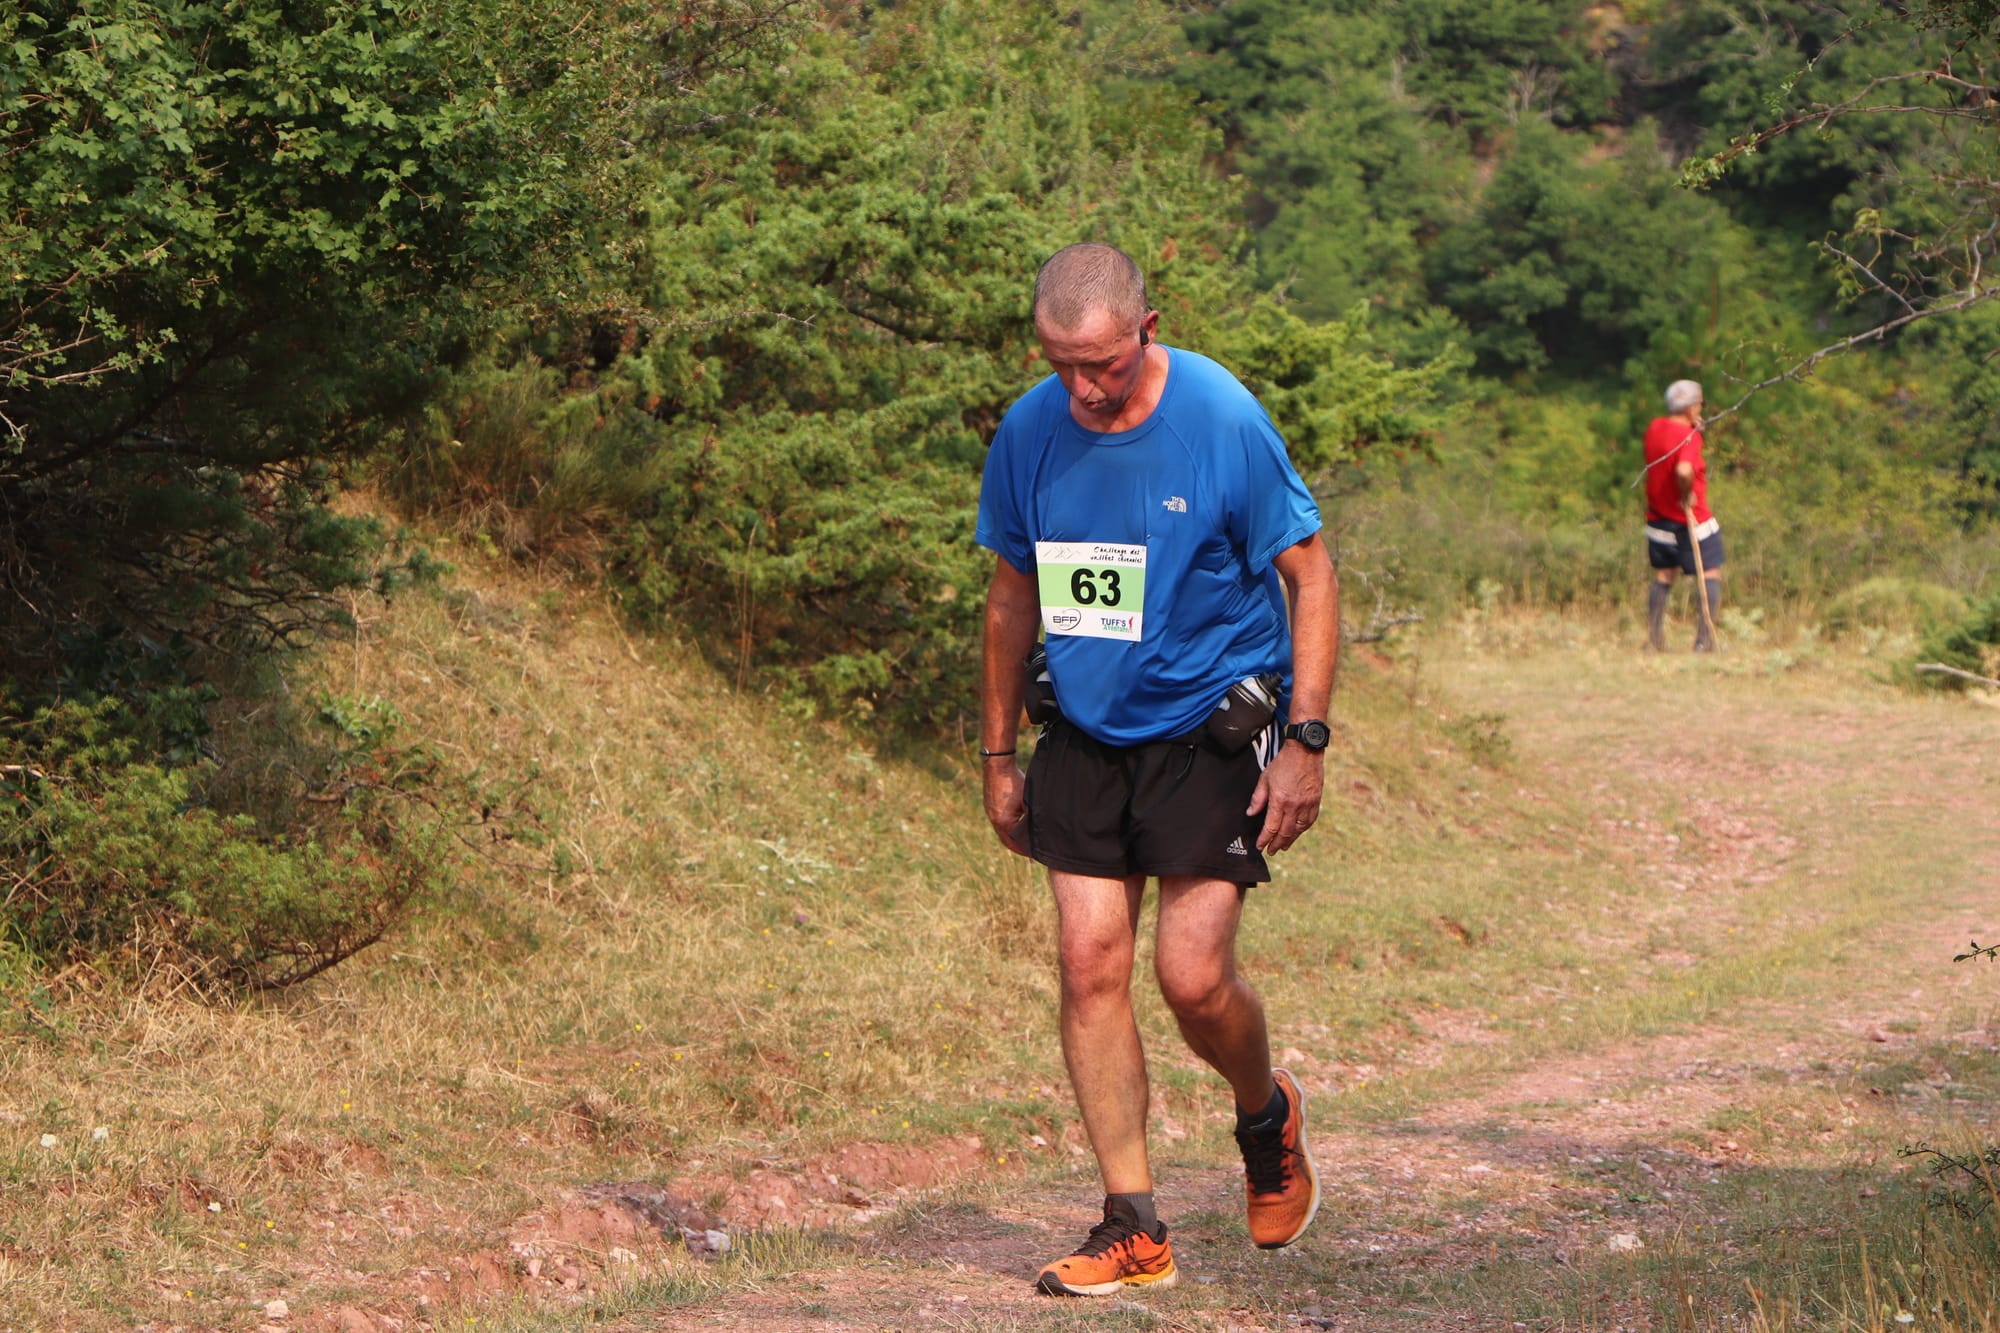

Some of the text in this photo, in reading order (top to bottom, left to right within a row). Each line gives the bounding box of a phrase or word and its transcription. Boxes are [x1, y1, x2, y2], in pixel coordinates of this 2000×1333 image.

[1094, 546, 1126, 556] Challenge
[1071, 568, 1121, 606] 63
[1052, 615, 1078, 624] BFP
[1100, 617, 1126, 627] TUFF'S
[1226, 847, 1247, 855] adidas
